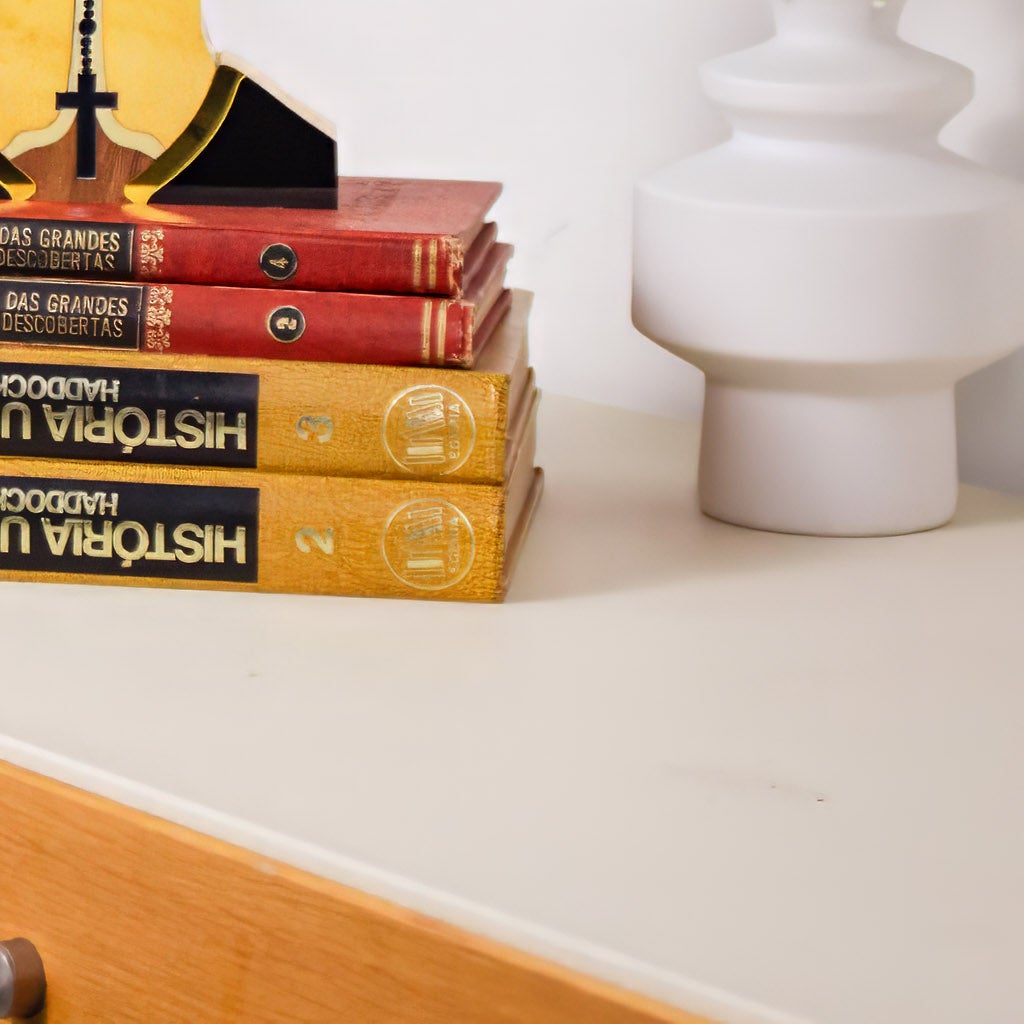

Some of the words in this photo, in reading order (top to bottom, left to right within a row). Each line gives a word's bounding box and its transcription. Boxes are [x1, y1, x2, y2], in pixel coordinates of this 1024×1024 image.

[0, 226, 32, 247] DAS
[39, 228, 120, 253] GRANDES
[6, 291, 39, 311] DAS
[47, 293, 129, 317] GRANDES
[2, 313, 123, 338] DESCOBERTAS
[42, 403, 248, 454] HISTÓRIA
[295, 415, 334, 444] 3
[41, 517, 247, 568] HISTÓRIA
[295, 527, 334, 555] 2
